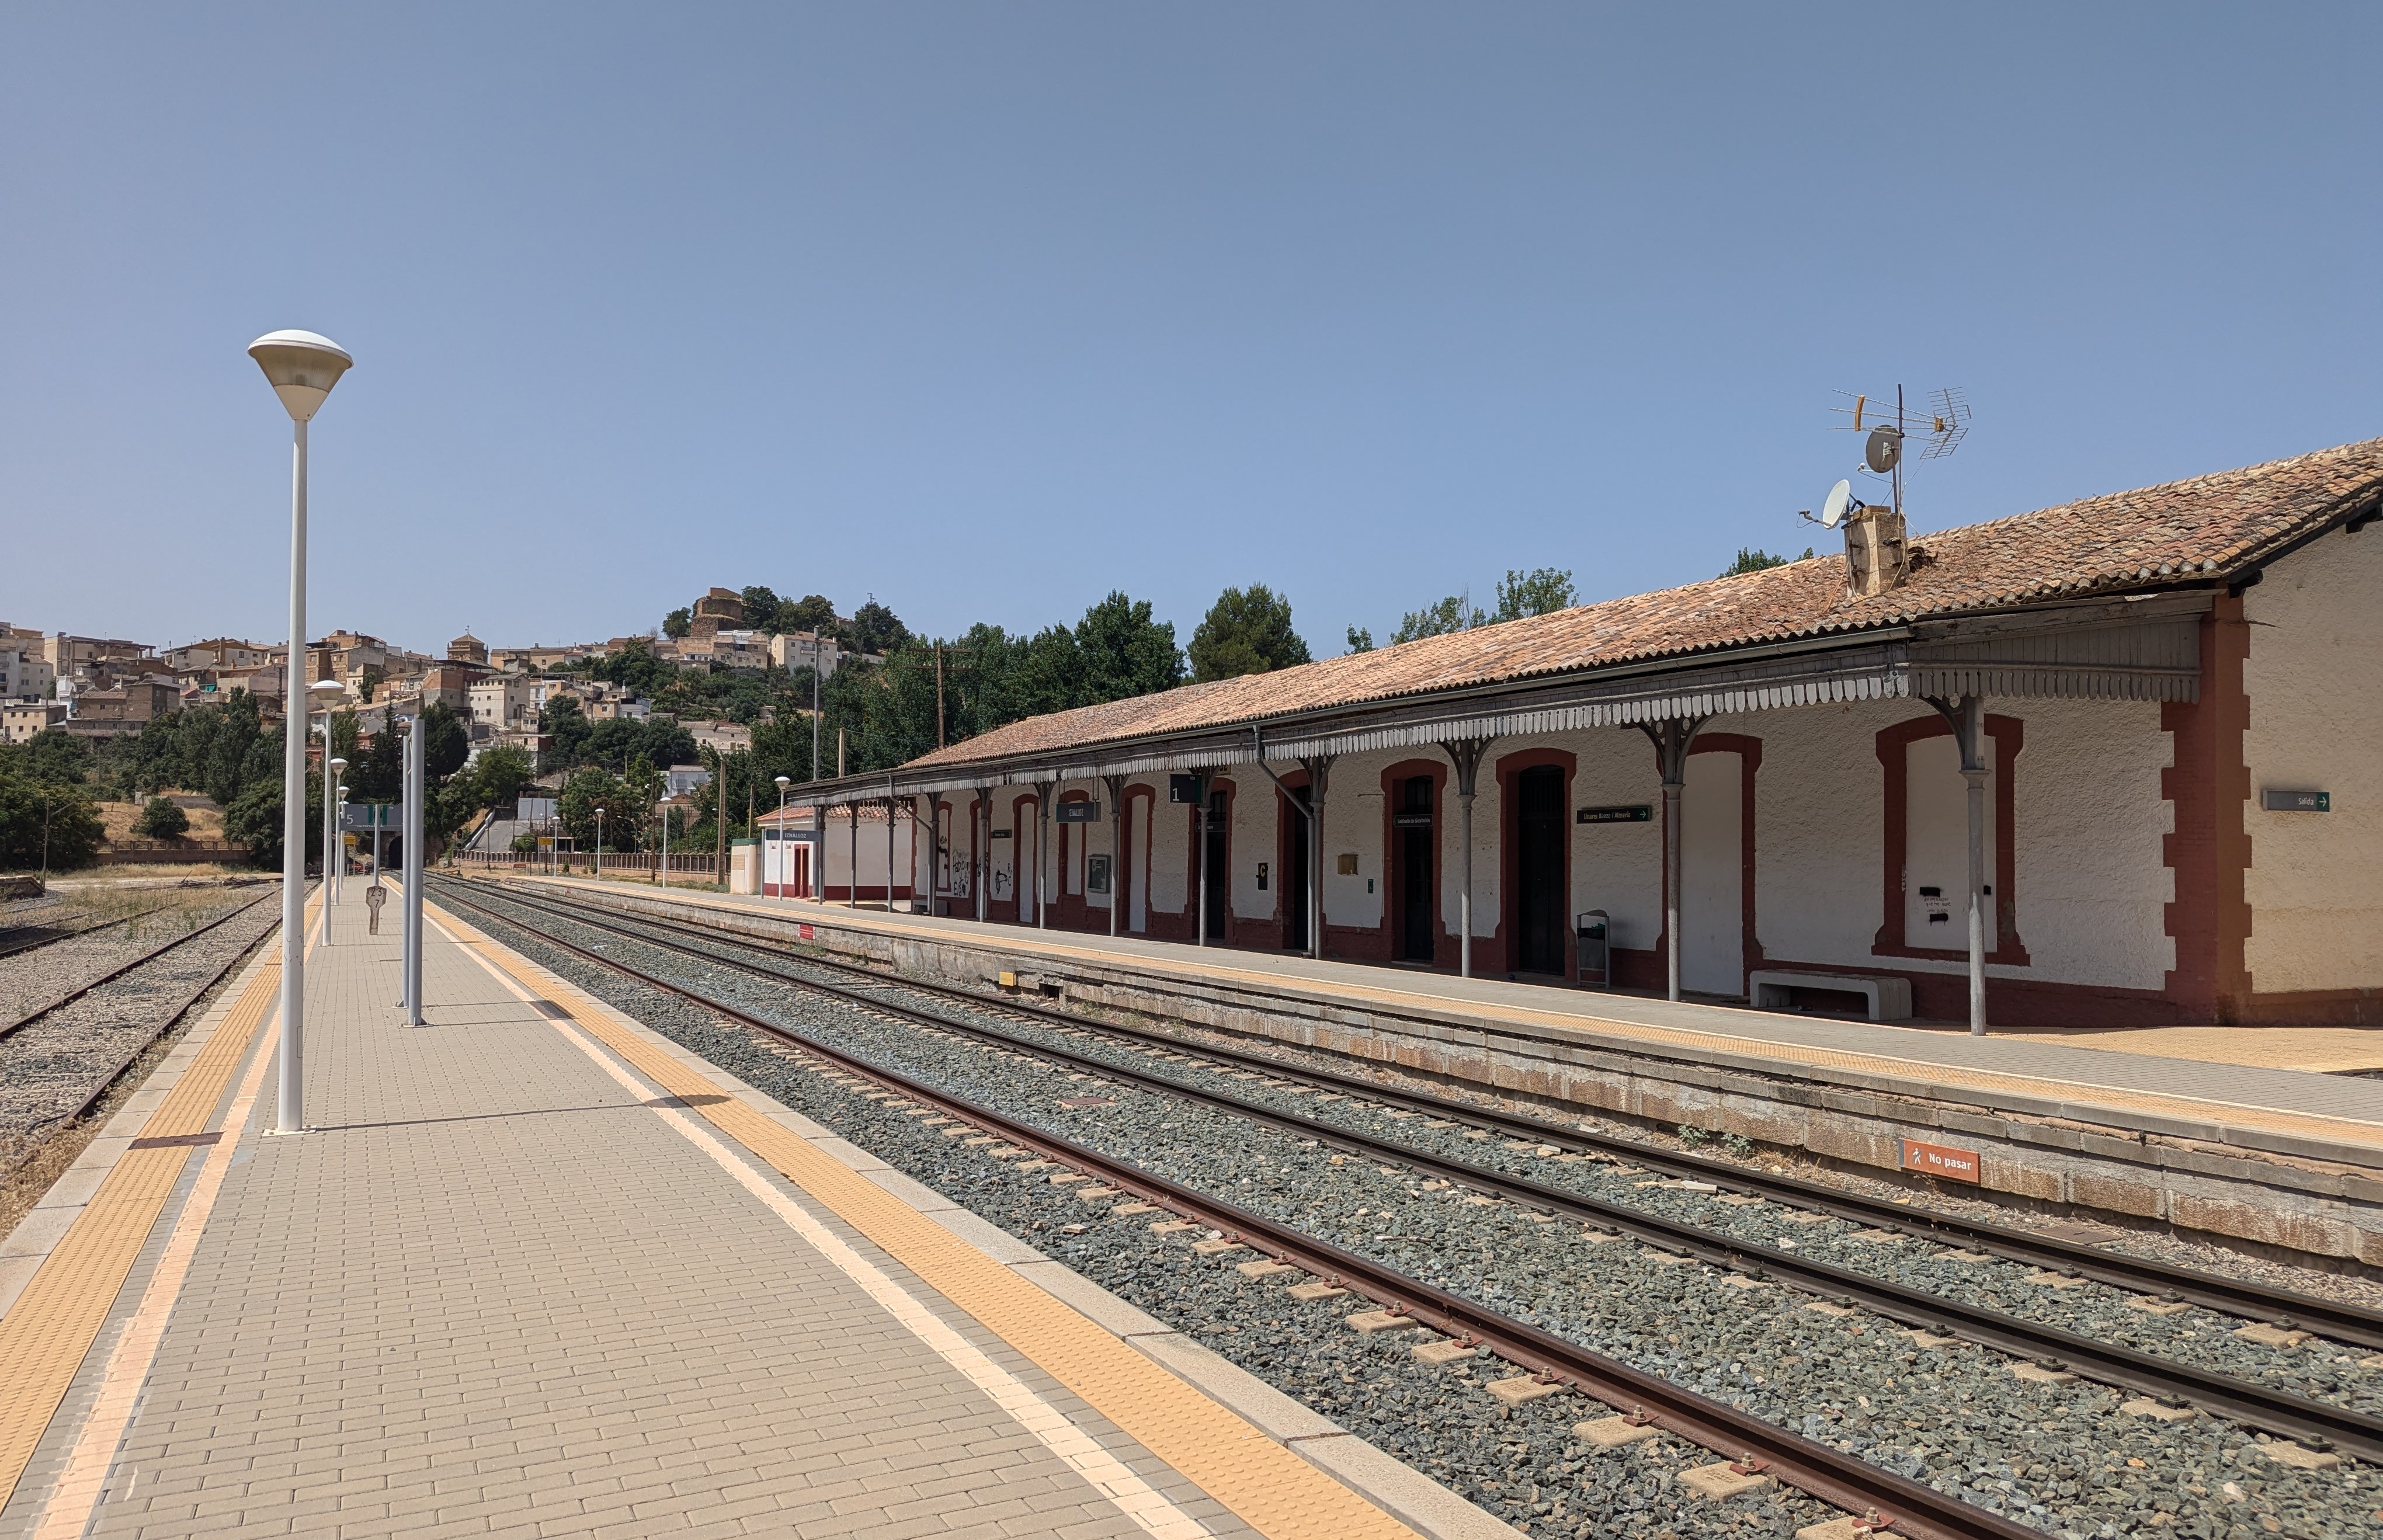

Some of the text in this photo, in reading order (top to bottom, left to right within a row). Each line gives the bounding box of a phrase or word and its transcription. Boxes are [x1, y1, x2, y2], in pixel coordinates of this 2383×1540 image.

[1172, 787, 1180, 801] 1
[2298, 797, 2314, 805] Salida
[346, 814, 353, 824] 5
[371, 887, 383, 896] 23
[375, 899, 380, 908] 7
[1929, 1153, 1972, 1170] No pasar
